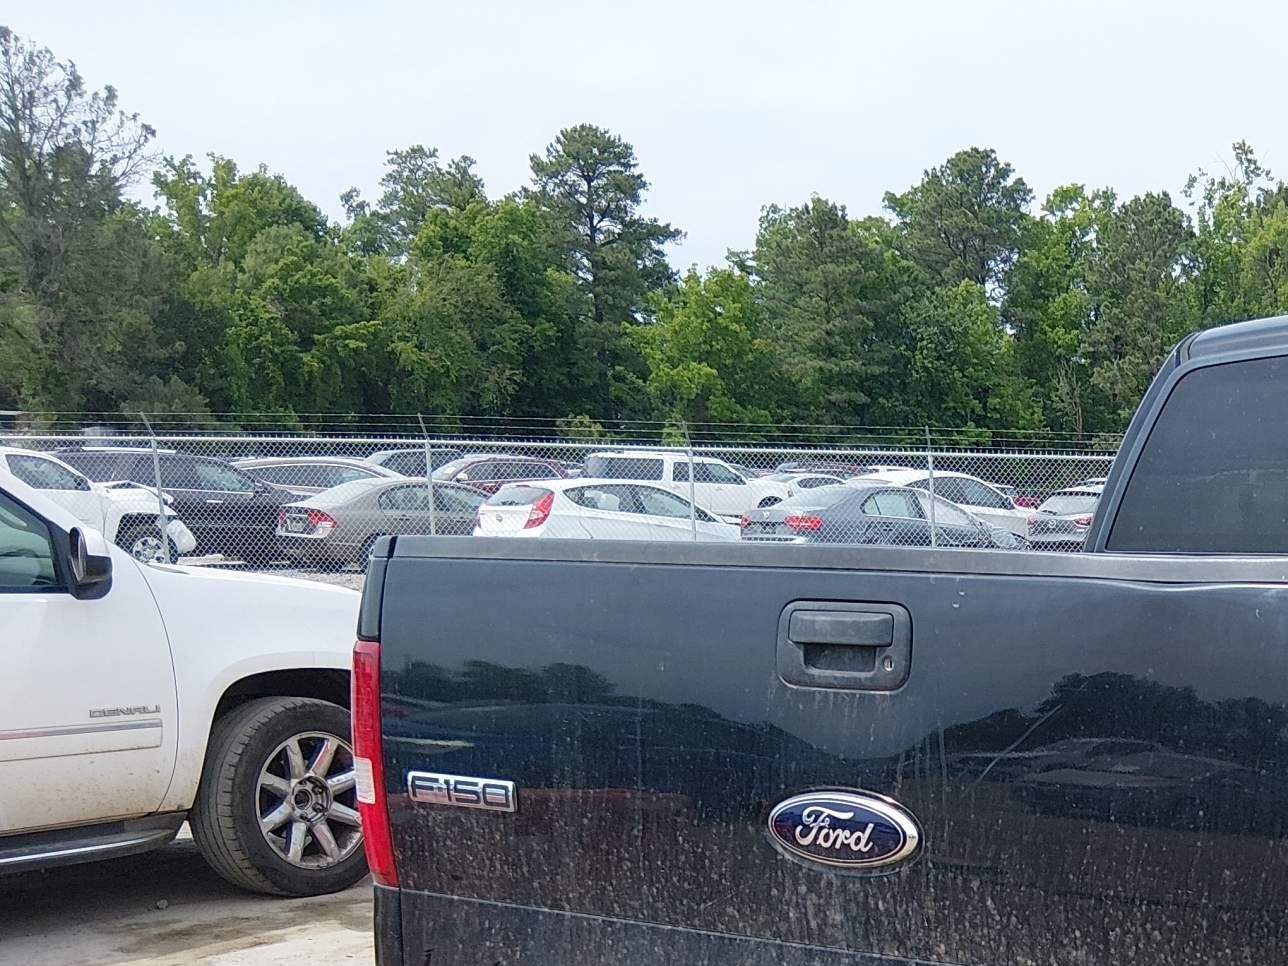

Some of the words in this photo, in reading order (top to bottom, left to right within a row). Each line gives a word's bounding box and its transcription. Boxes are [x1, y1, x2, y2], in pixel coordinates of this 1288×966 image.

[88, 704, 161, 718] DENALI
[410, 774, 512, 810] F-150
[794, 805, 875, 853] Ford
